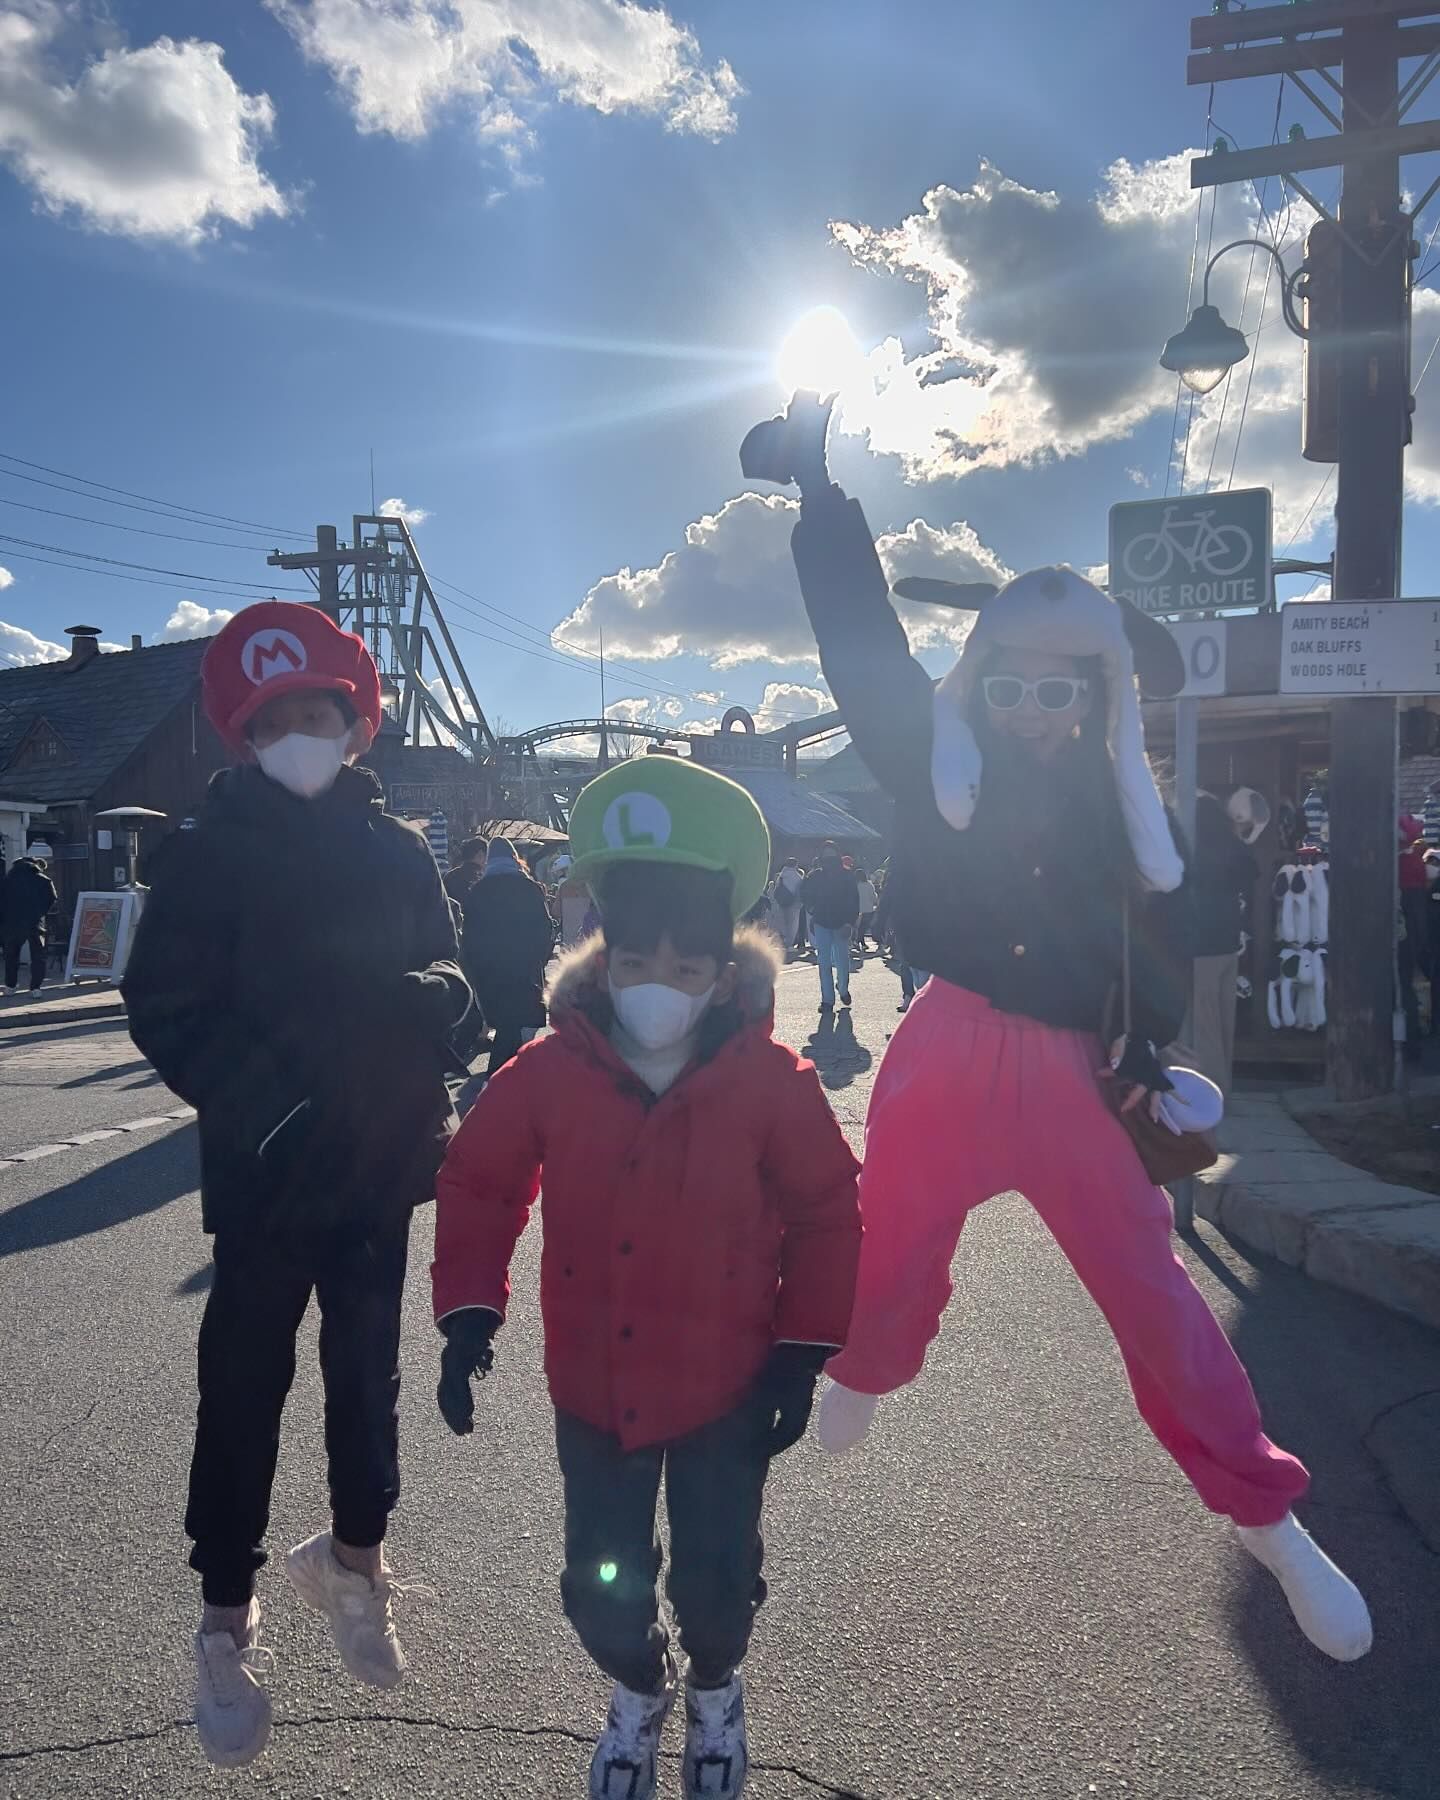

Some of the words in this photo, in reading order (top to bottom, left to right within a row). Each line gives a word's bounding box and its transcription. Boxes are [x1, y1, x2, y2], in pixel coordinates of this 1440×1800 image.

[1180, 578, 1256, 606] ROUTE
[1292, 617, 1328, 630] AMITY
[1330, 616, 1369, 630] BEACH
[1290, 640, 1314, 654] OAK
[1317, 639, 1362, 654] BLUFFS
[252, 637, 303, 681] M
[1290, 663, 1333, 677] WOODS
[1337, 663, 1367, 676] HOLE
[704, 741, 775, 760] GAMES
[617, 803, 655, 847] L
